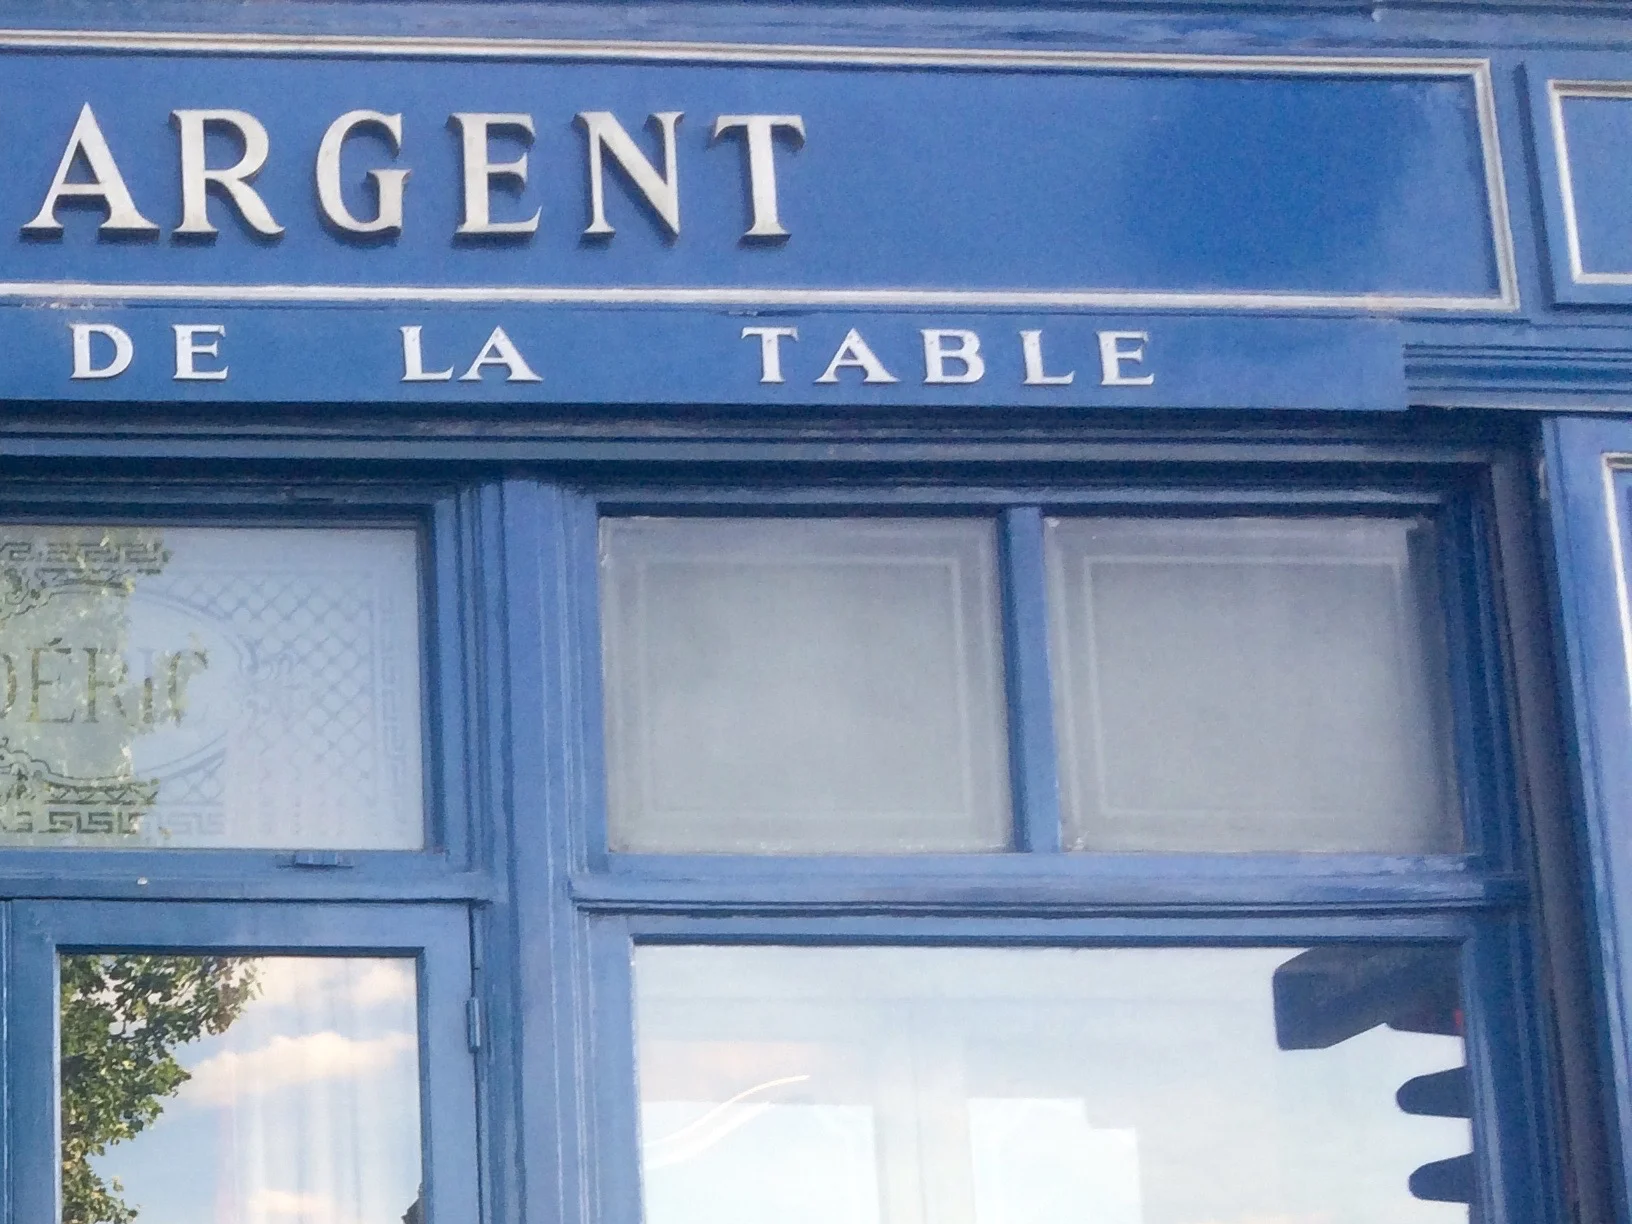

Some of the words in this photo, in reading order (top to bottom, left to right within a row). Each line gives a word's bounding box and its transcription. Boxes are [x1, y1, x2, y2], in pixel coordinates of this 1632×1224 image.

[68, 322, 228, 381] DE
[400, 325, 542, 383] LA
[741, 326, 1155, 387] TABLE
